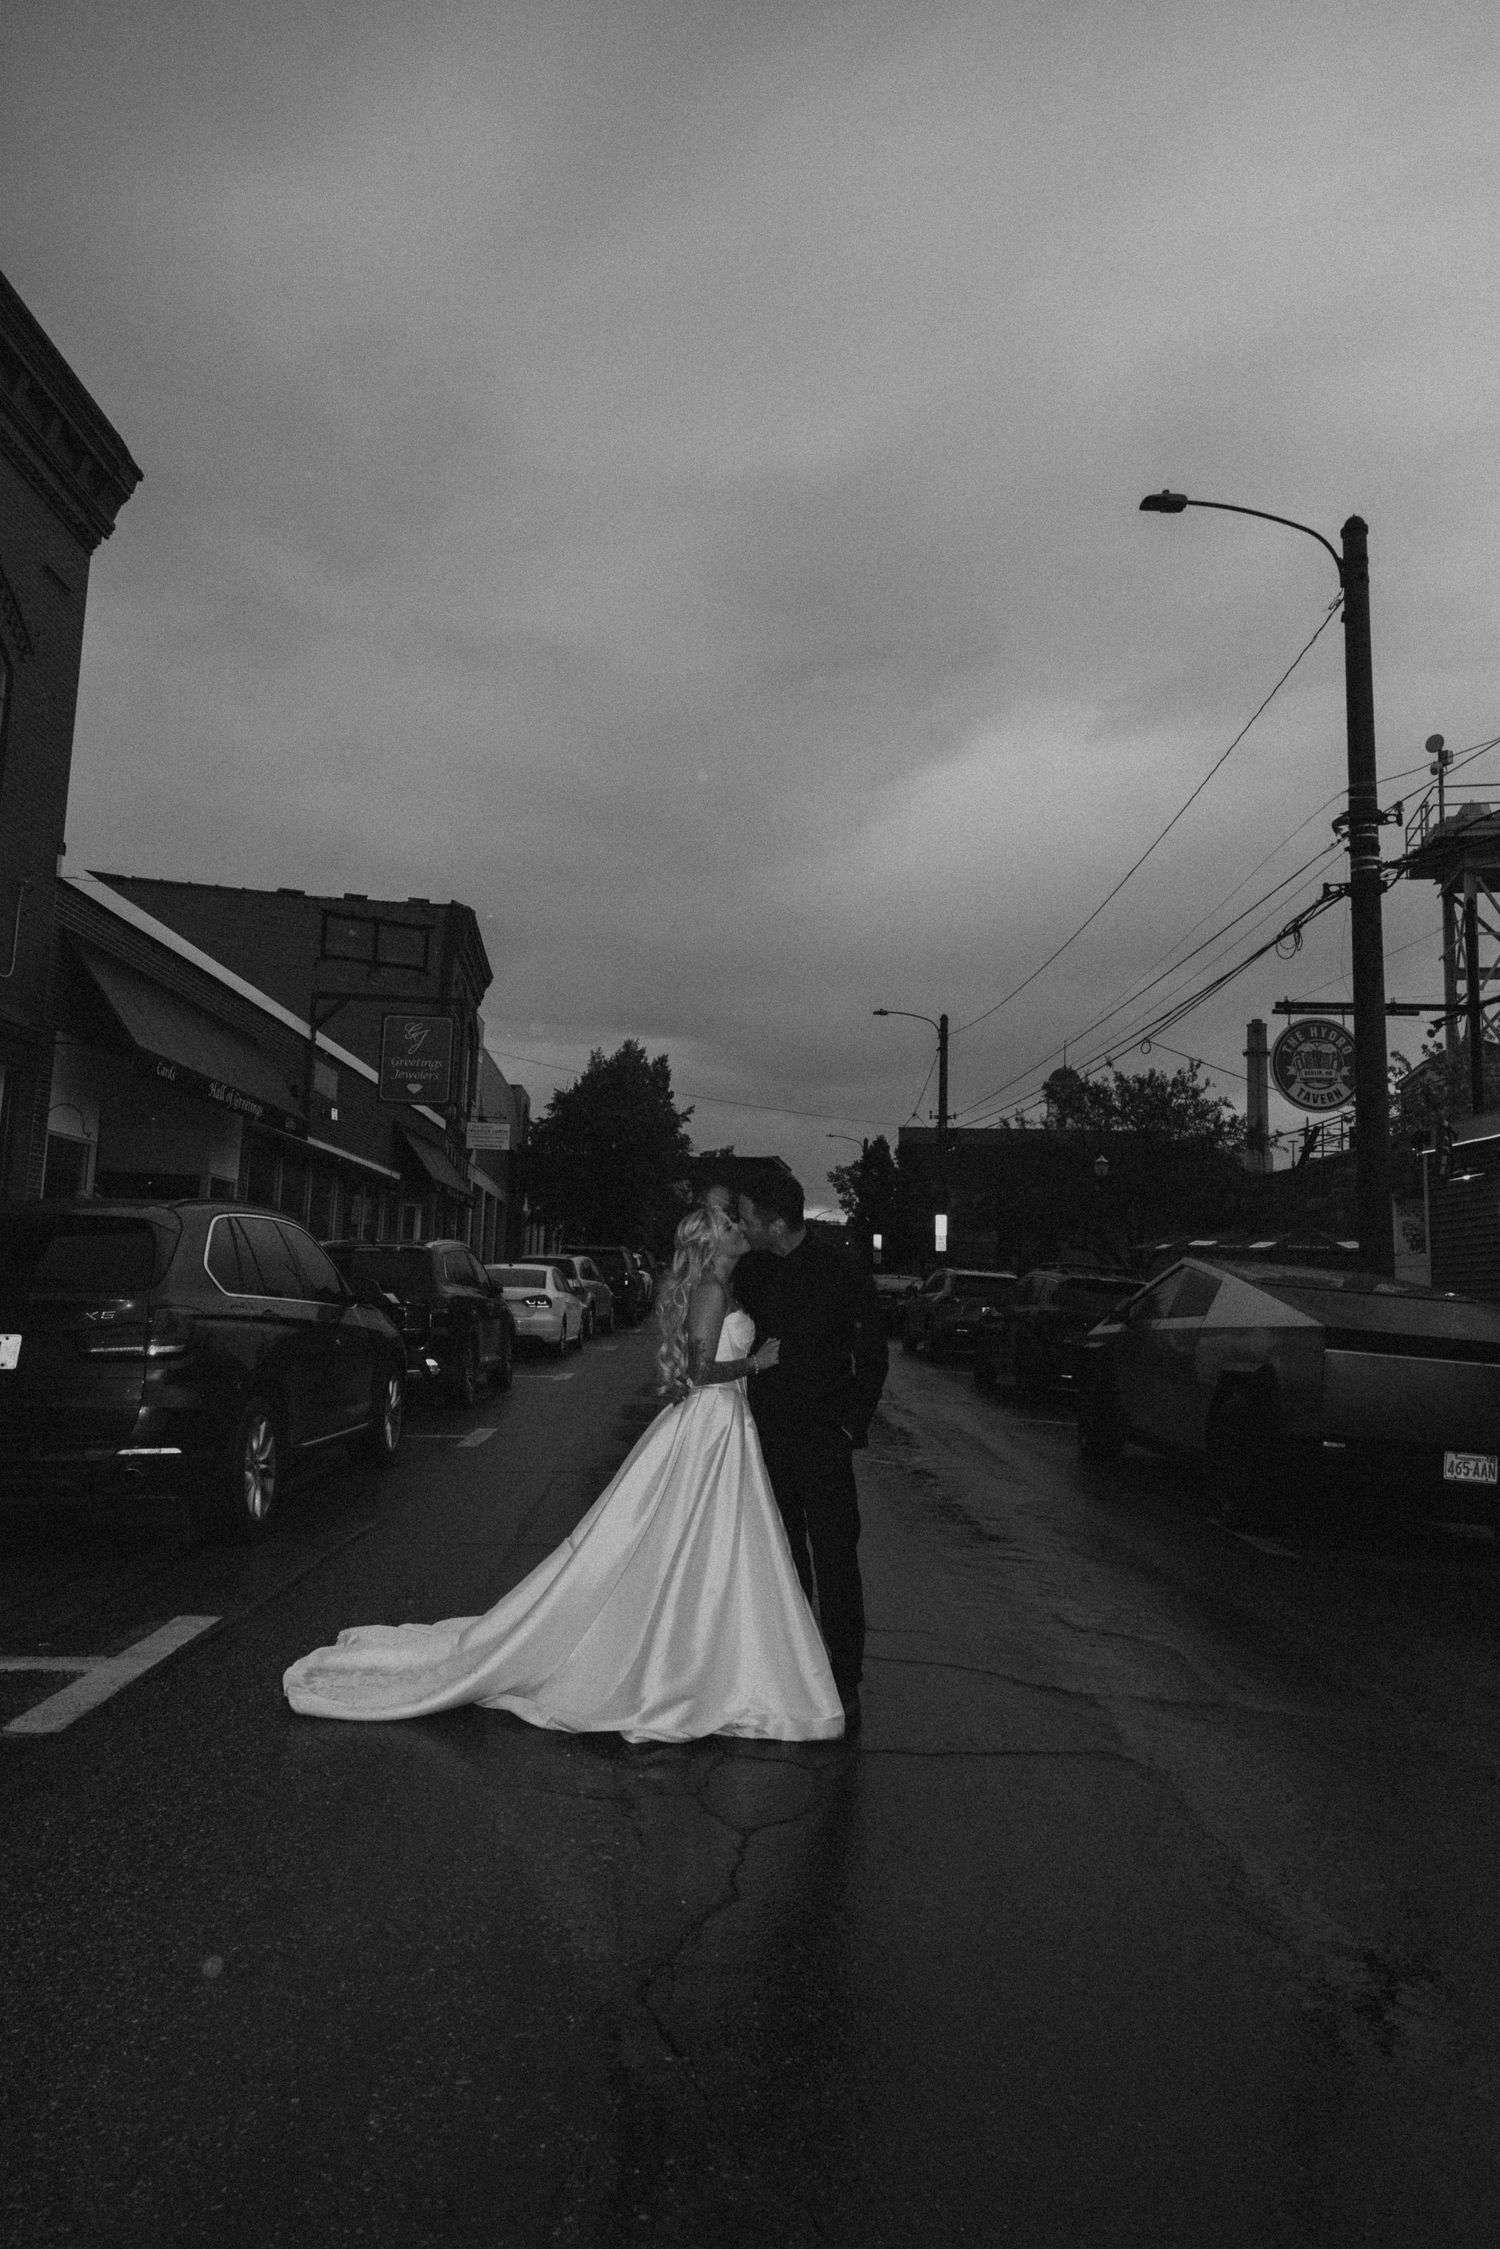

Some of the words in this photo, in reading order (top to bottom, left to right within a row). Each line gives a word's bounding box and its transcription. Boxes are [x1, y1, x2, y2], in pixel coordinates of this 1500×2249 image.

[1282, 1030, 1305, 1054] THE
[1309, 1026, 1353, 1055] HYDRO
[390, 1056, 443, 1070] Greetings
[390, 1069, 440, 1081] Jewelers
[208, 1081, 227, 1101] Hall
[1296, 1087, 1344, 1105] TAVERN
